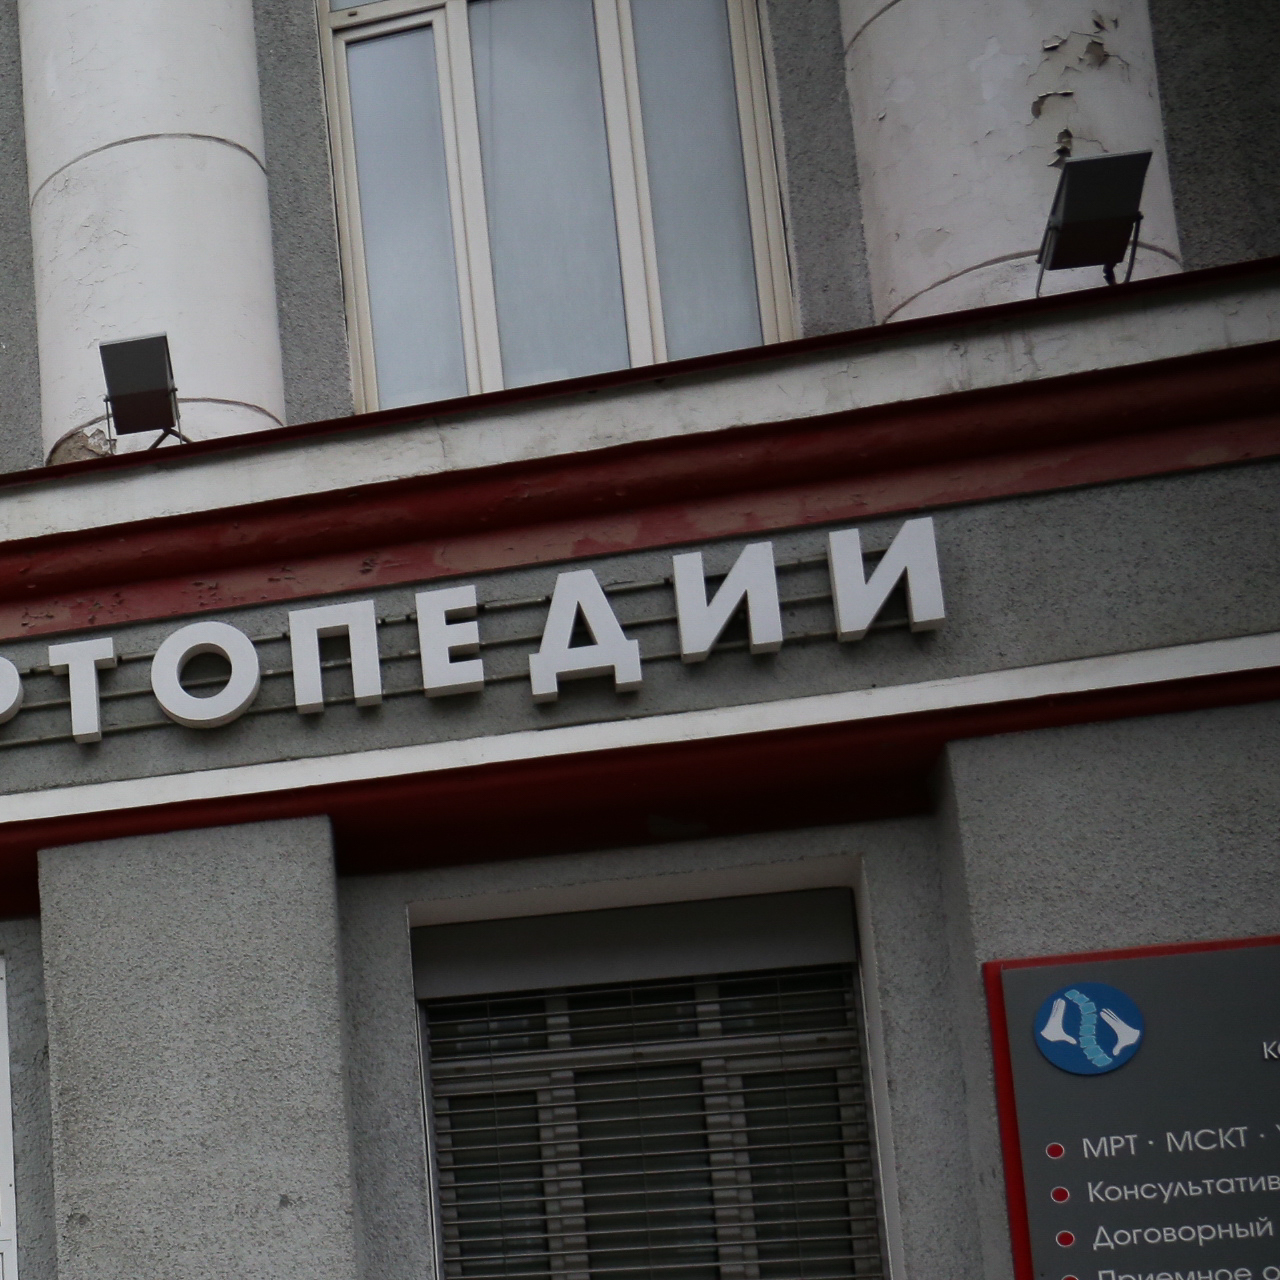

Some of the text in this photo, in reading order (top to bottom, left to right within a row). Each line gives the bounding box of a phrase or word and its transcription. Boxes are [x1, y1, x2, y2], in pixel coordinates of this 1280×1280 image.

[1263, 1041, 1280, 1059] К
[1082, 1126, 1248, 1159] МРТ МСКТ
[1087, 1174, 1280, 1204] Консультатив
[1092, 1216, 1274, 1251] Договорный
